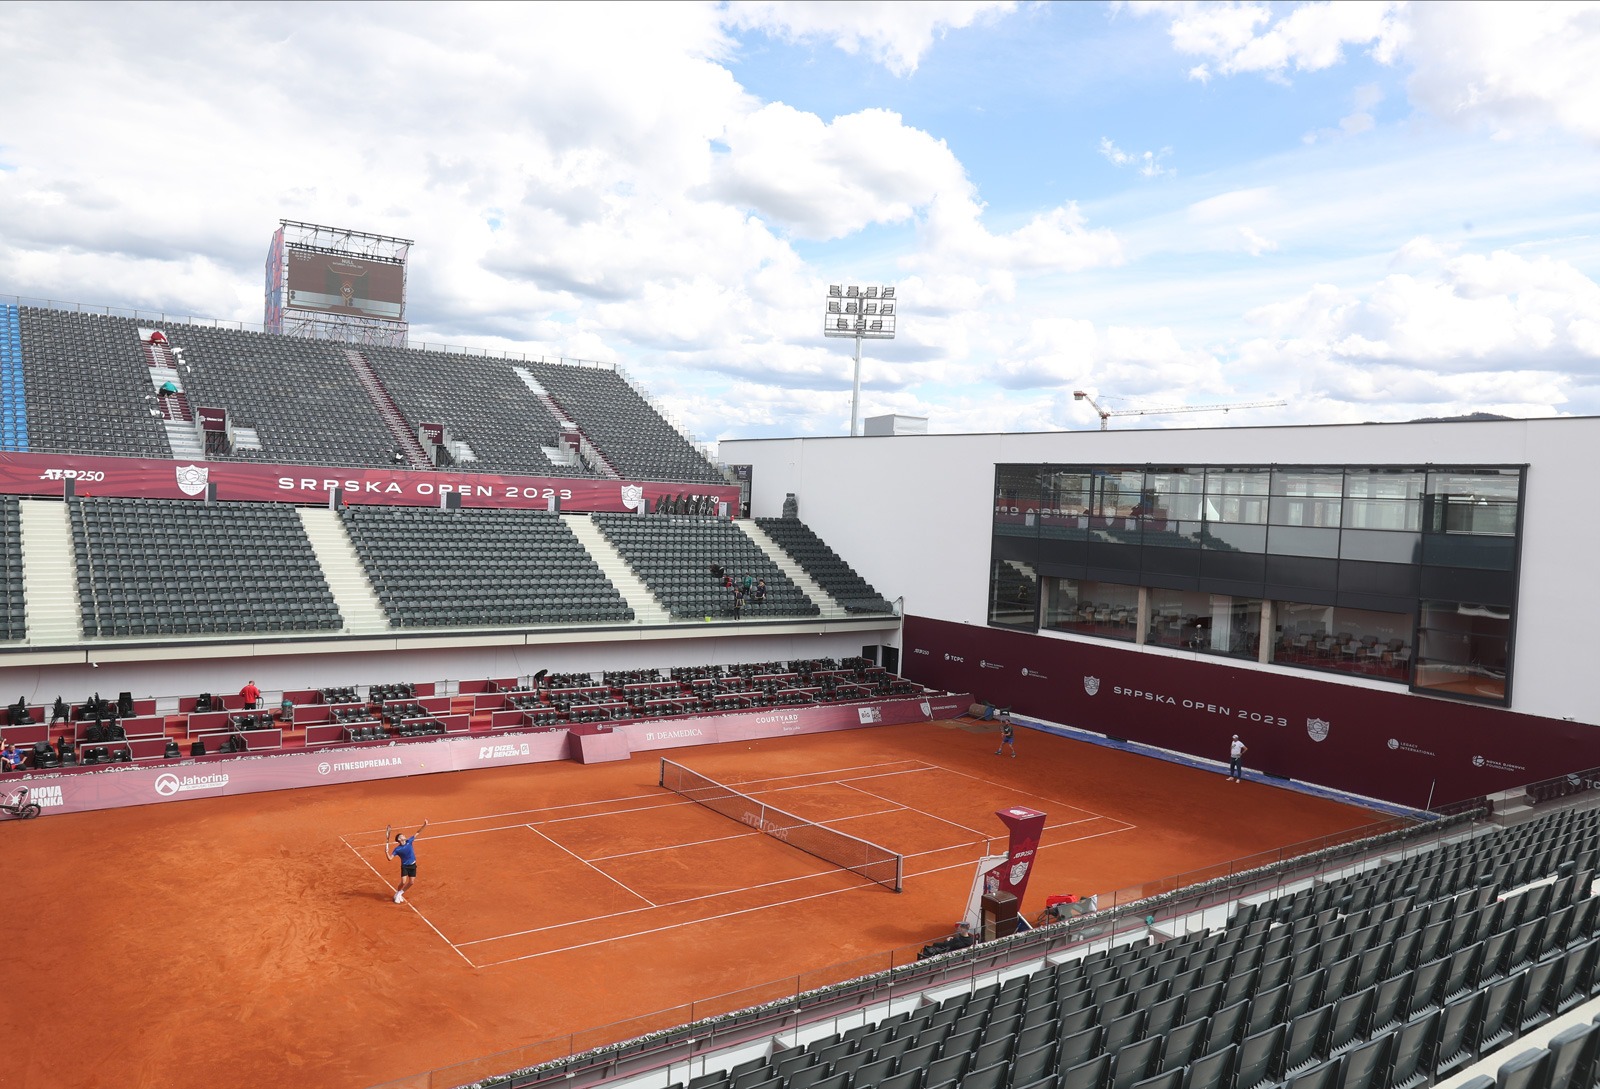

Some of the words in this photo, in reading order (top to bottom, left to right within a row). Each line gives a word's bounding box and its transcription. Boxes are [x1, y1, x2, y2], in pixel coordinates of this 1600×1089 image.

[278, 477, 402, 494] SRPSKA
[416, 483, 493, 497] OPEN
[505, 487, 572, 500] 2023
[950, 655, 964, 663] TCPC
[1113, 686, 1176, 705] SRPSKA
[1182, 700, 1231, 715] OPEN
[1238, 710, 1287, 727] 2023
[755, 714, 798, 724] COURTYARD
[657, 729, 703, 740] DEAMEDICA
[493, 749, 520, 758] BENZIN
[494, 744, 516, 752] DIZEL
[1400, 746, 1436, 757] INTERNATIONAL
[333, 757, 402, 772] FITNESOPREMA.BA
[180, 773, 229, 786] Jahorina
[30, 785, 63, 799] NOVA
